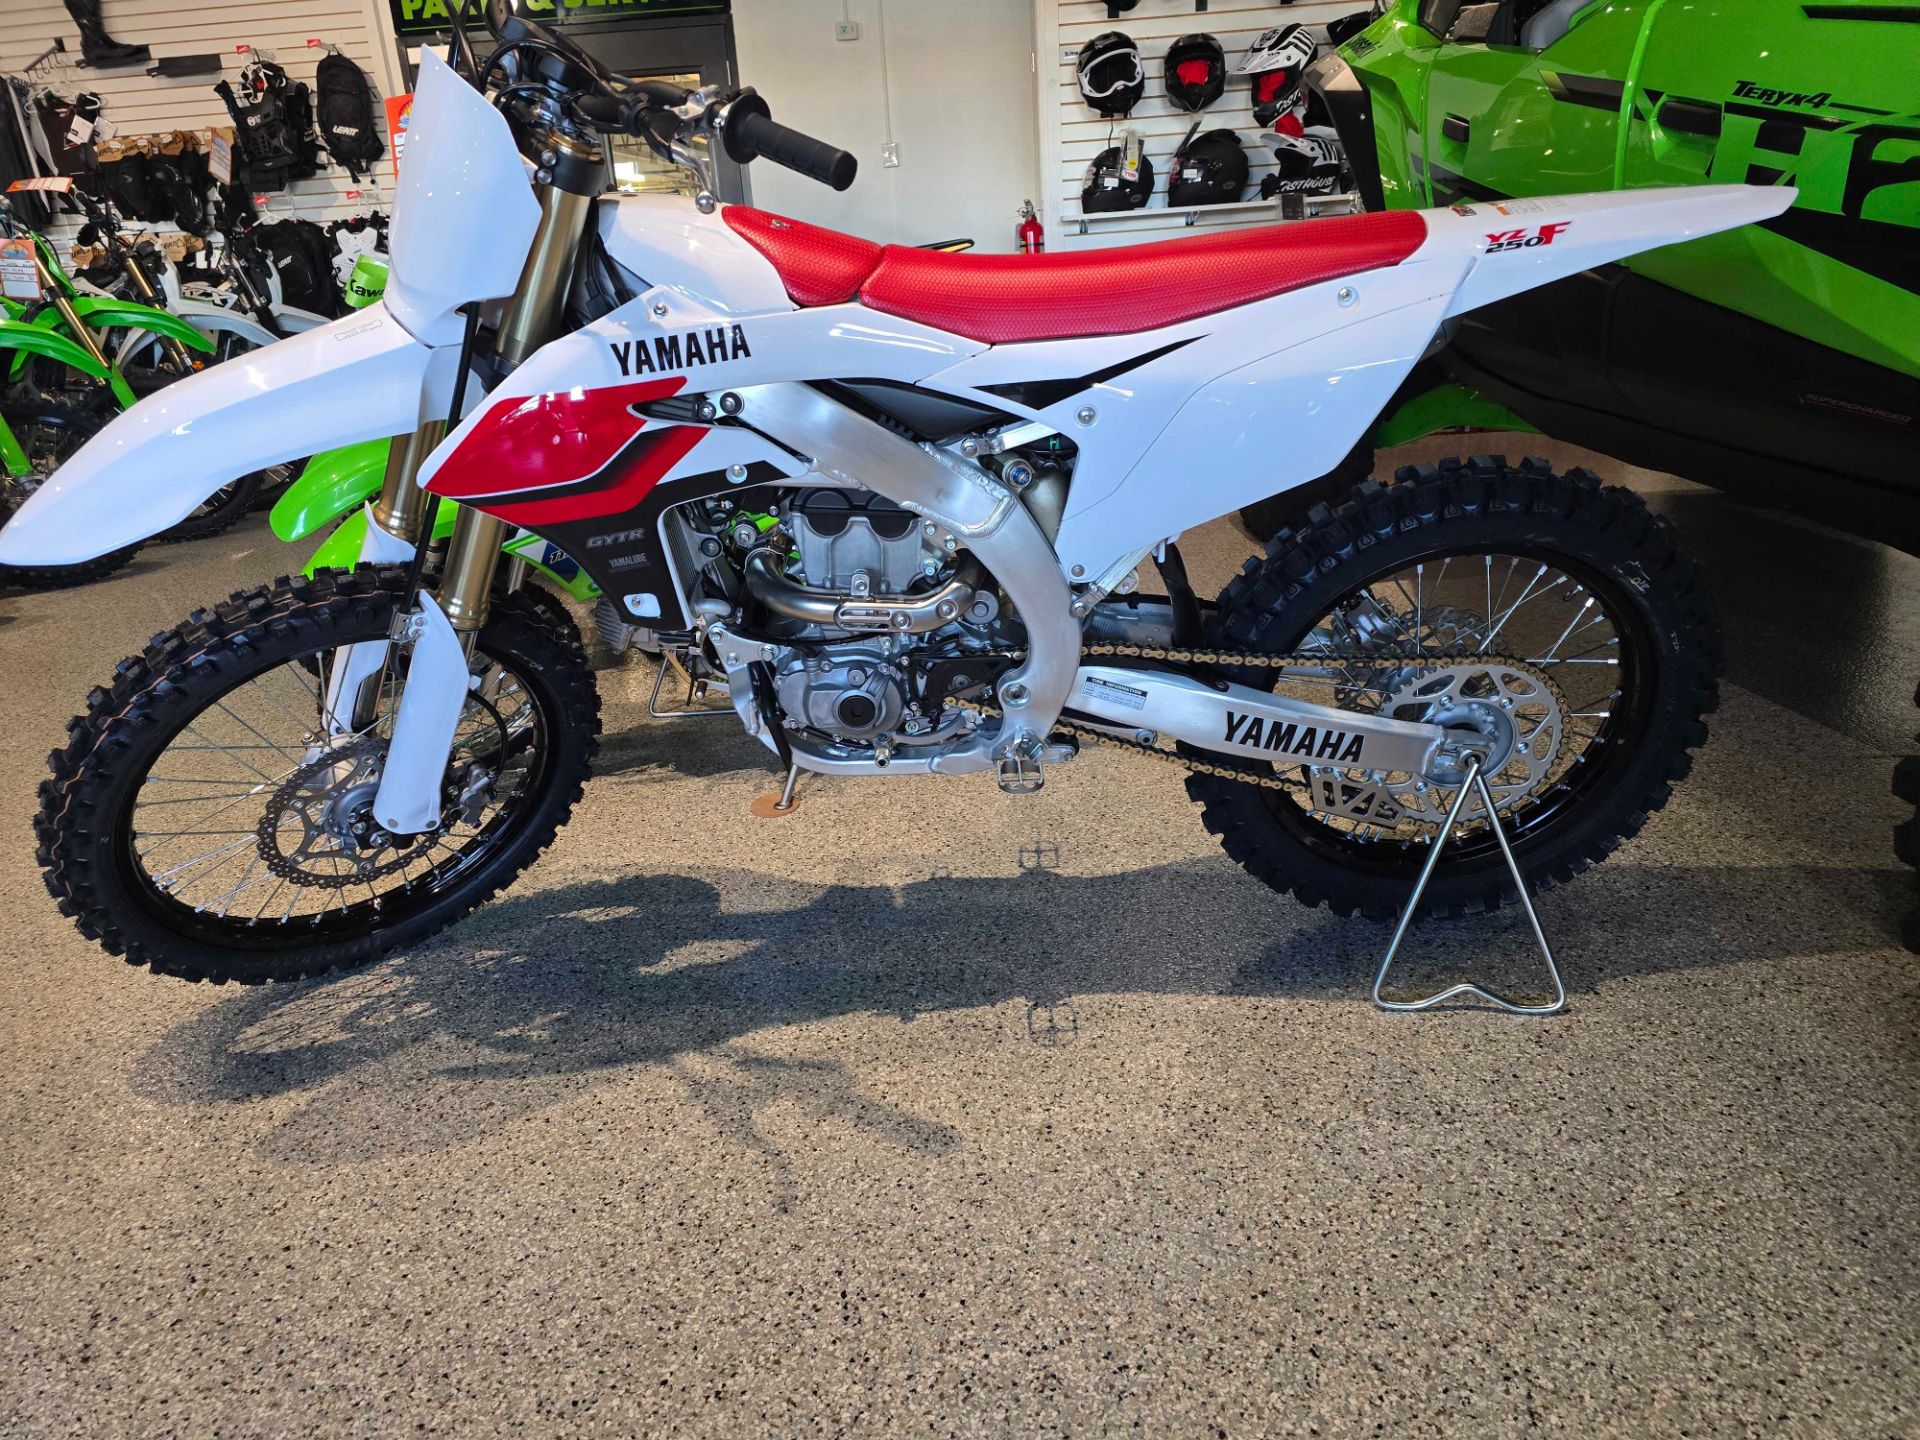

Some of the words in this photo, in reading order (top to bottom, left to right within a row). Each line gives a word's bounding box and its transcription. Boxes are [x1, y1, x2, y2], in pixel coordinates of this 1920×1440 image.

[610, 324, 752, 376] YAMAHA
[585, 527, 646, 549] GYTR
[608, 552, 648, 568] YAMALUBE
[1224, 711, 1365, 763] YAMAHA
